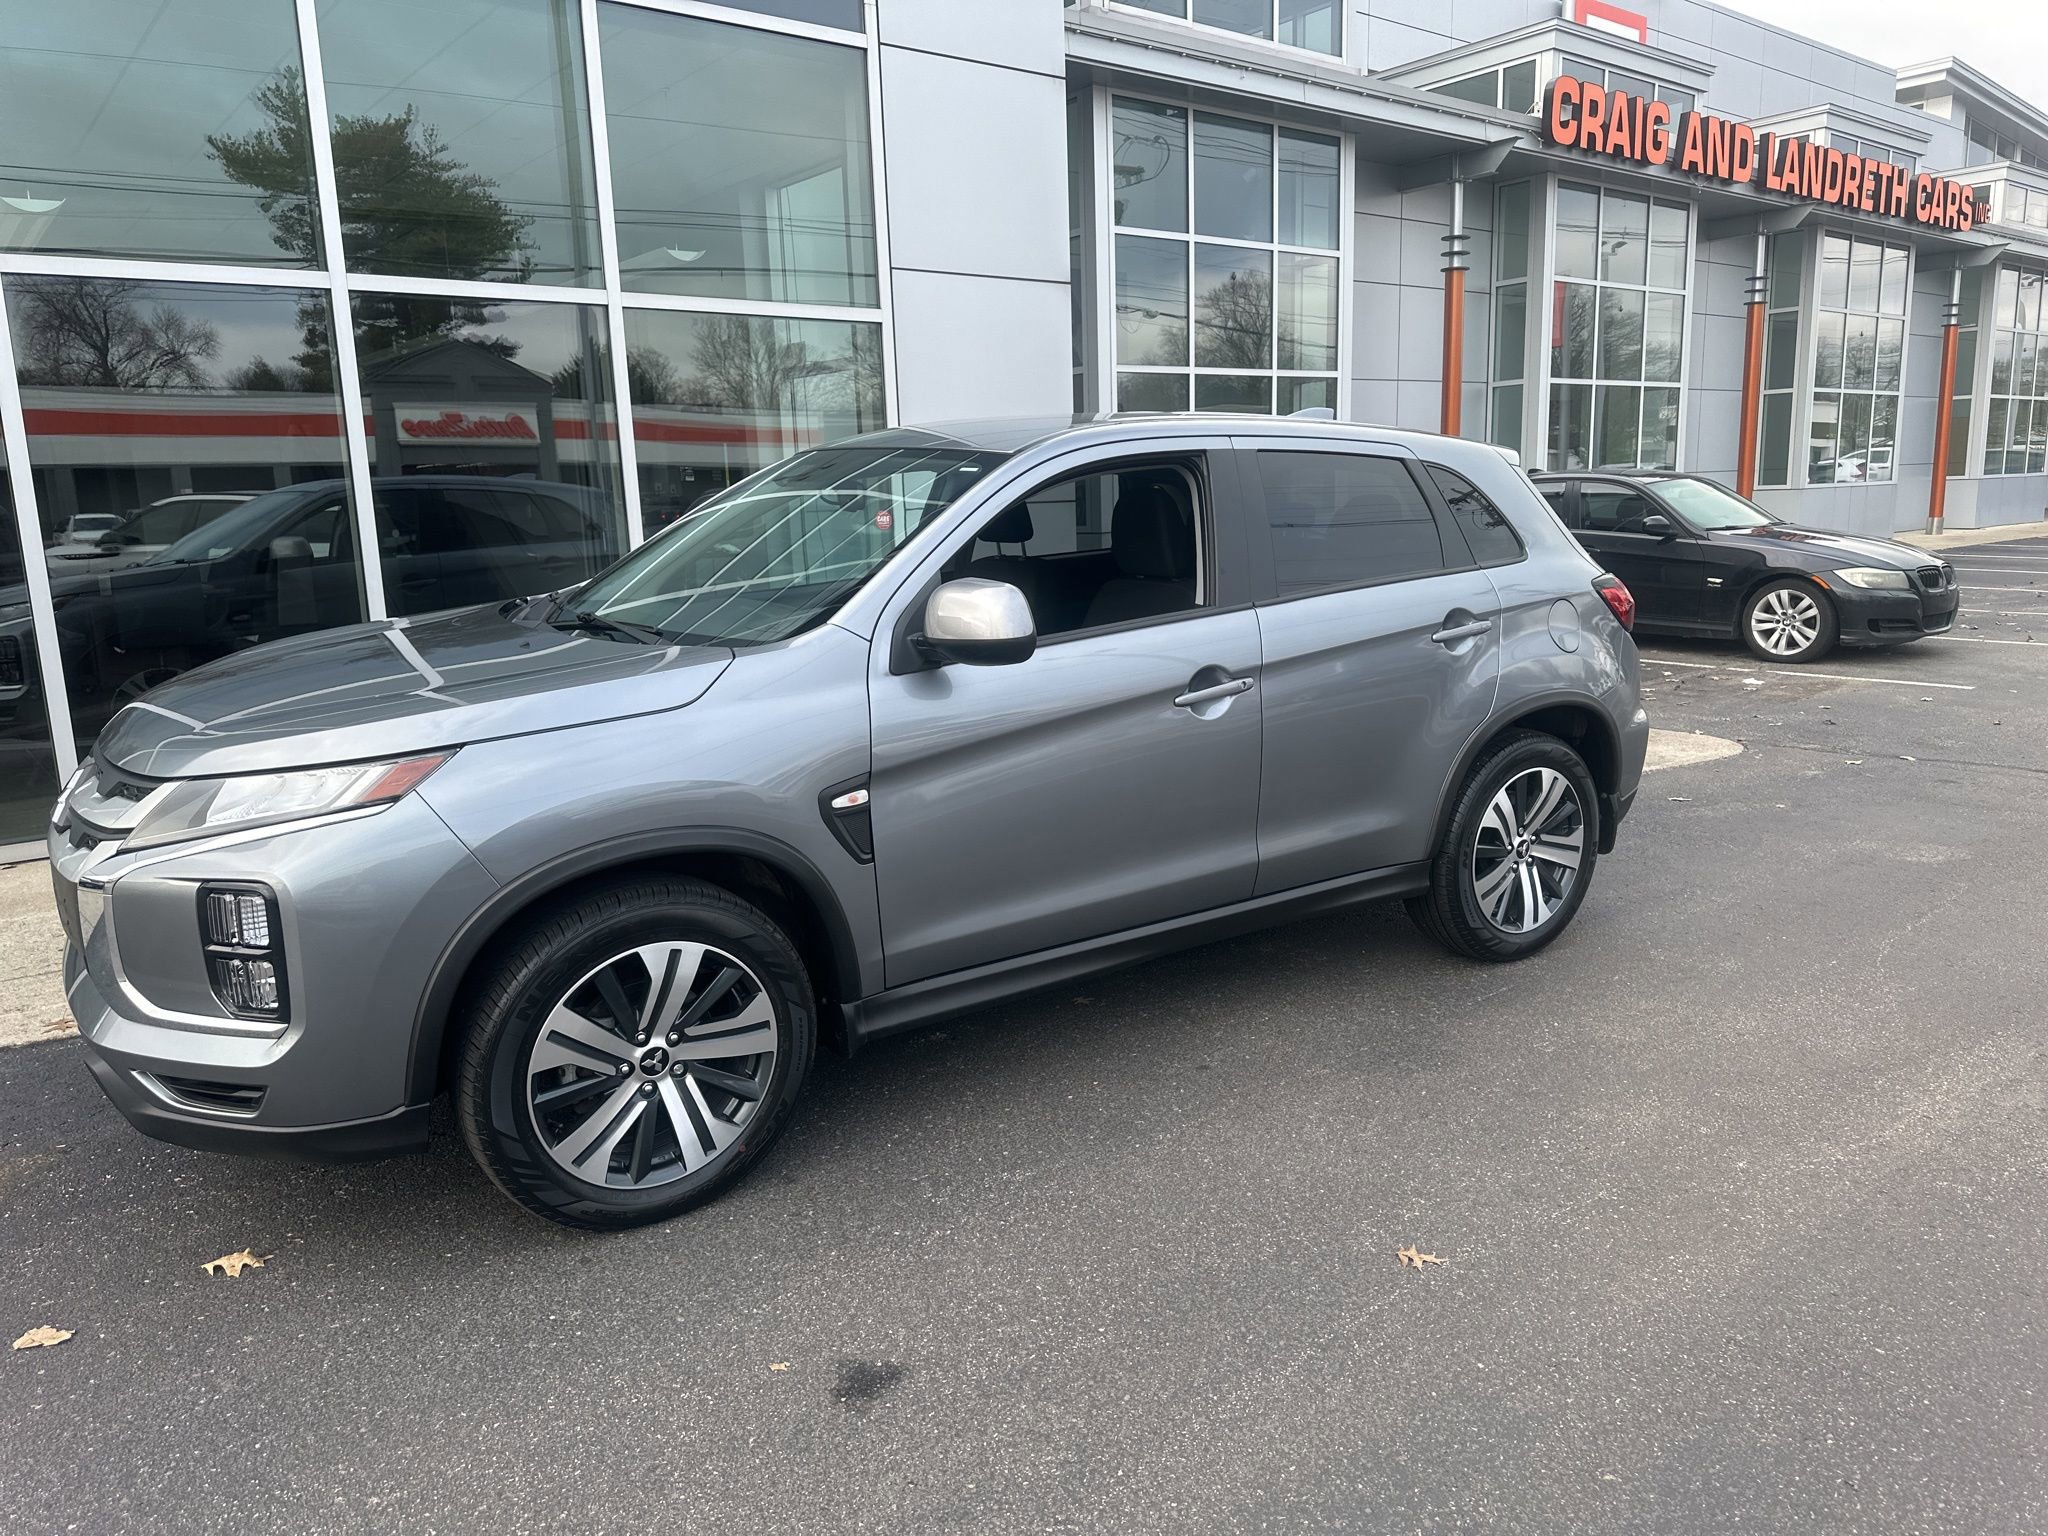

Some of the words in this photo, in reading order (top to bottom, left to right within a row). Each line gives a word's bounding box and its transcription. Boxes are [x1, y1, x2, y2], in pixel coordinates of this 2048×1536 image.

[1548, 75, 1670, 165] CRAIG
[1678, 111, 1754, 182] AND
[1765, 131, 1909, 217] LANDRETH
[1914, 173, 1974, 232] CARS
